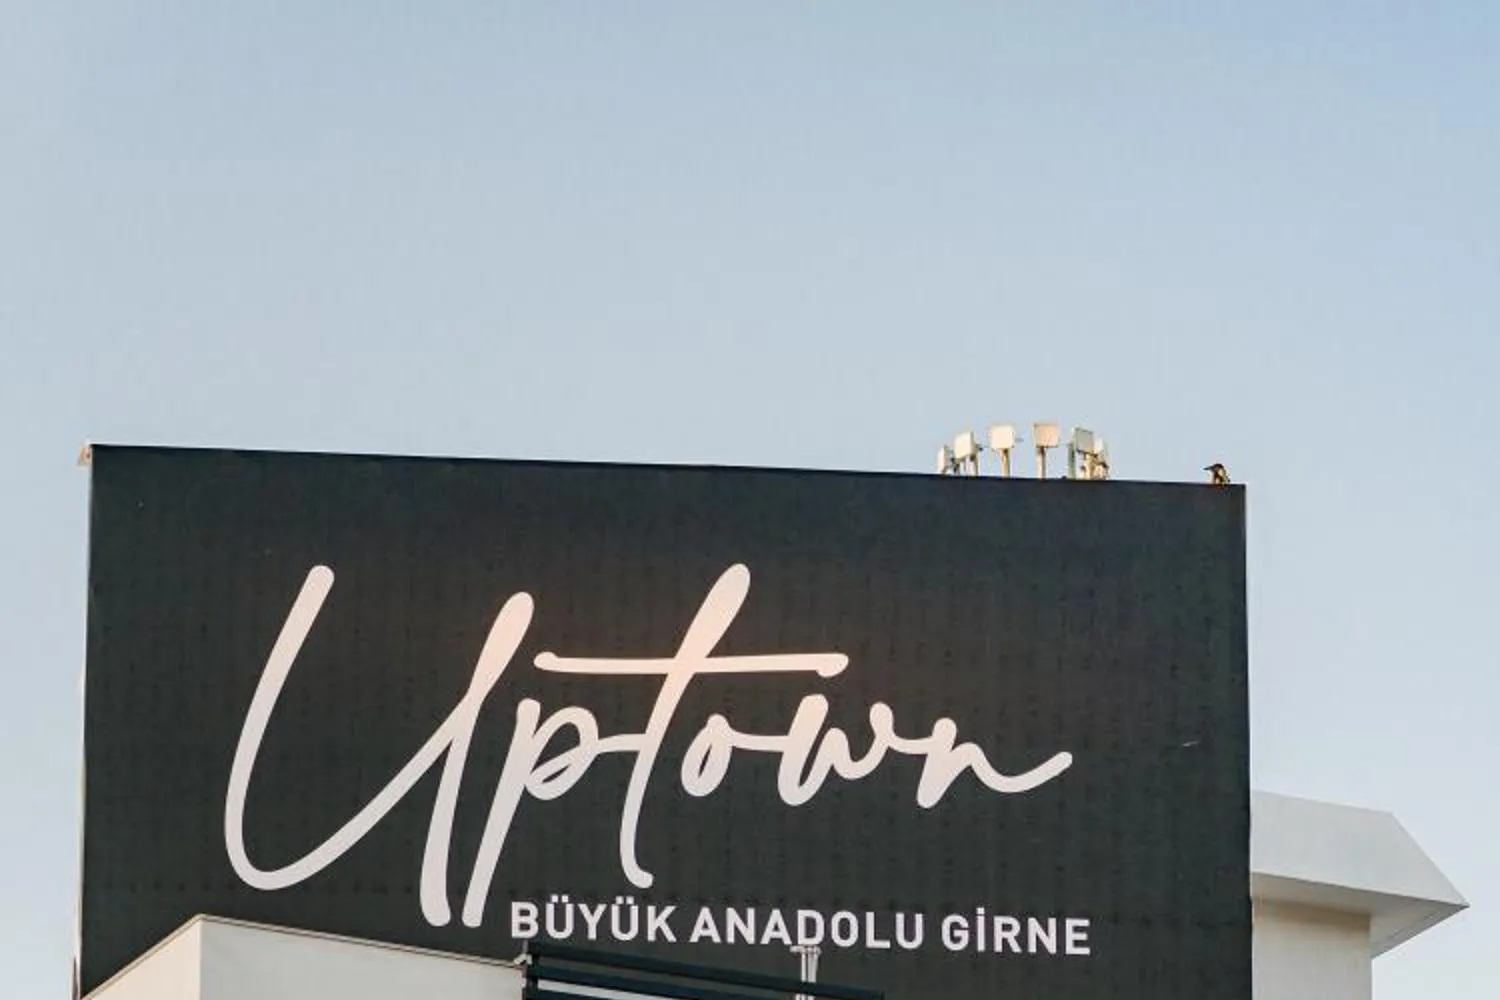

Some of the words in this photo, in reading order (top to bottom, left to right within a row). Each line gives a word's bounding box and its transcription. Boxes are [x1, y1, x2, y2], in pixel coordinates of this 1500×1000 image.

[225, 563, 1072, 927] Uptown
[510, 894, 677, 943] BÜYÜK
[689, 906, 924, 949] ANADOLU
[941, 906, 1091, 955] GİRNE
